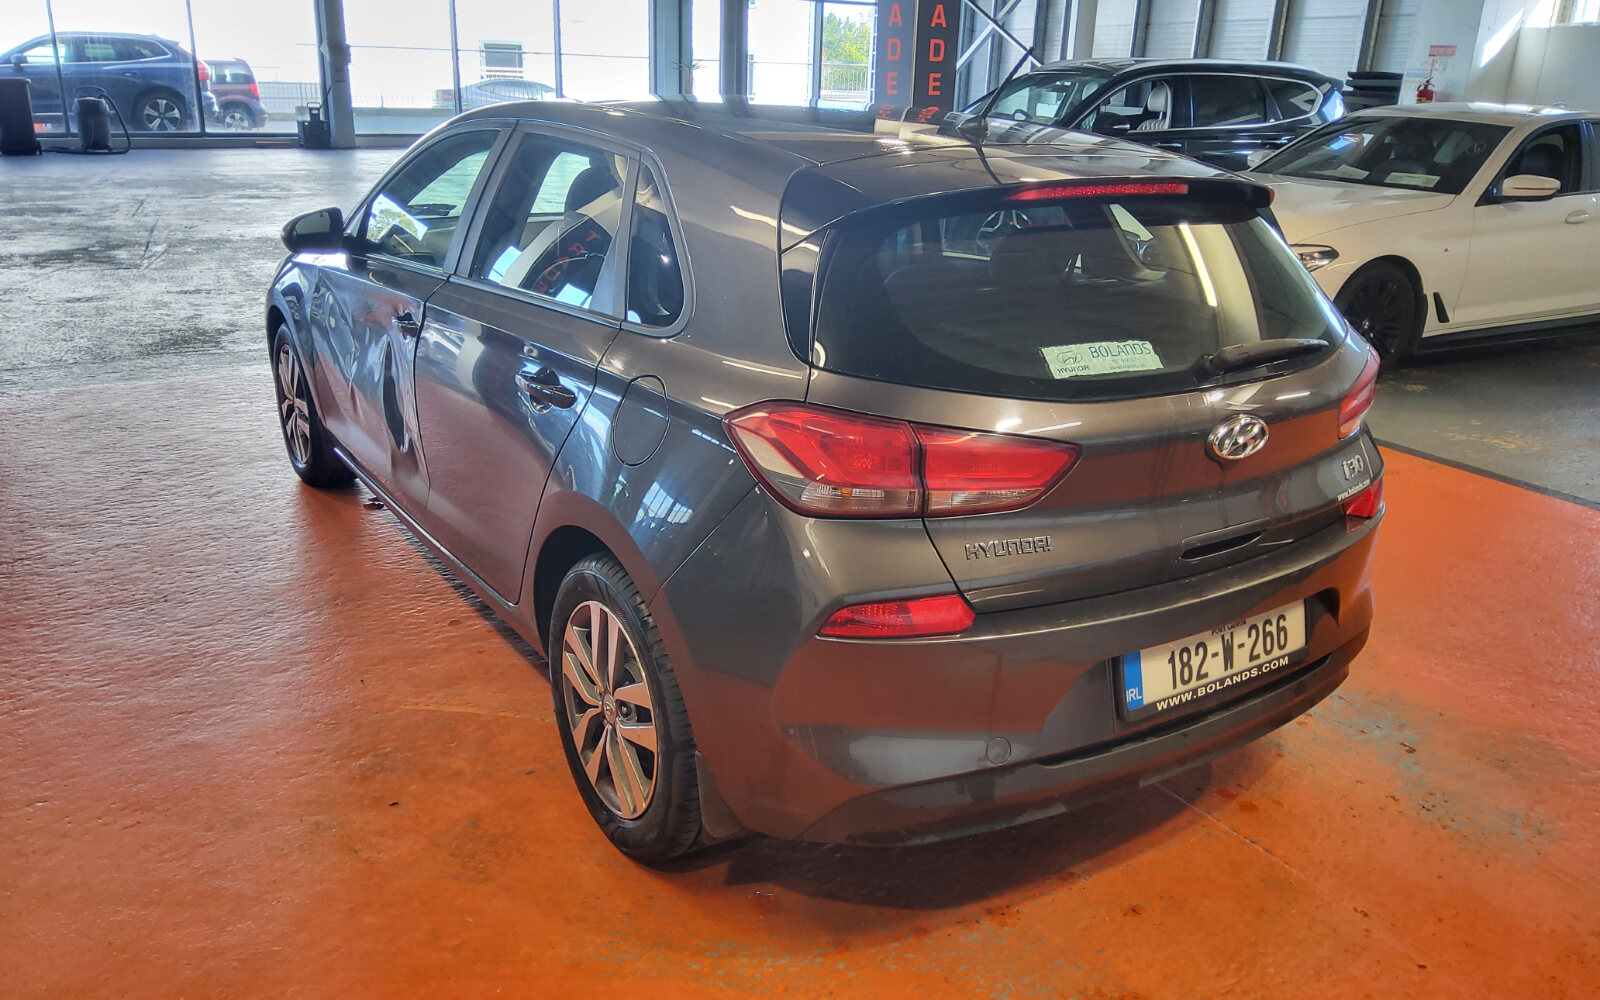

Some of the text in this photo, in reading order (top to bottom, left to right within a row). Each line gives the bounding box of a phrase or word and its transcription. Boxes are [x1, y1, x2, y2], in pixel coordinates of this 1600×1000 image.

[1088, 342, 1151, 359] BOLANDS
[965, 535, 1053, 560] HYUNDAI
[1167, 613, 1289, 690] 182-W-266
[1125, 686, 1143, 703] IRL
[1156, 655, 1289, 712] WWW.BOLANDS.COM
